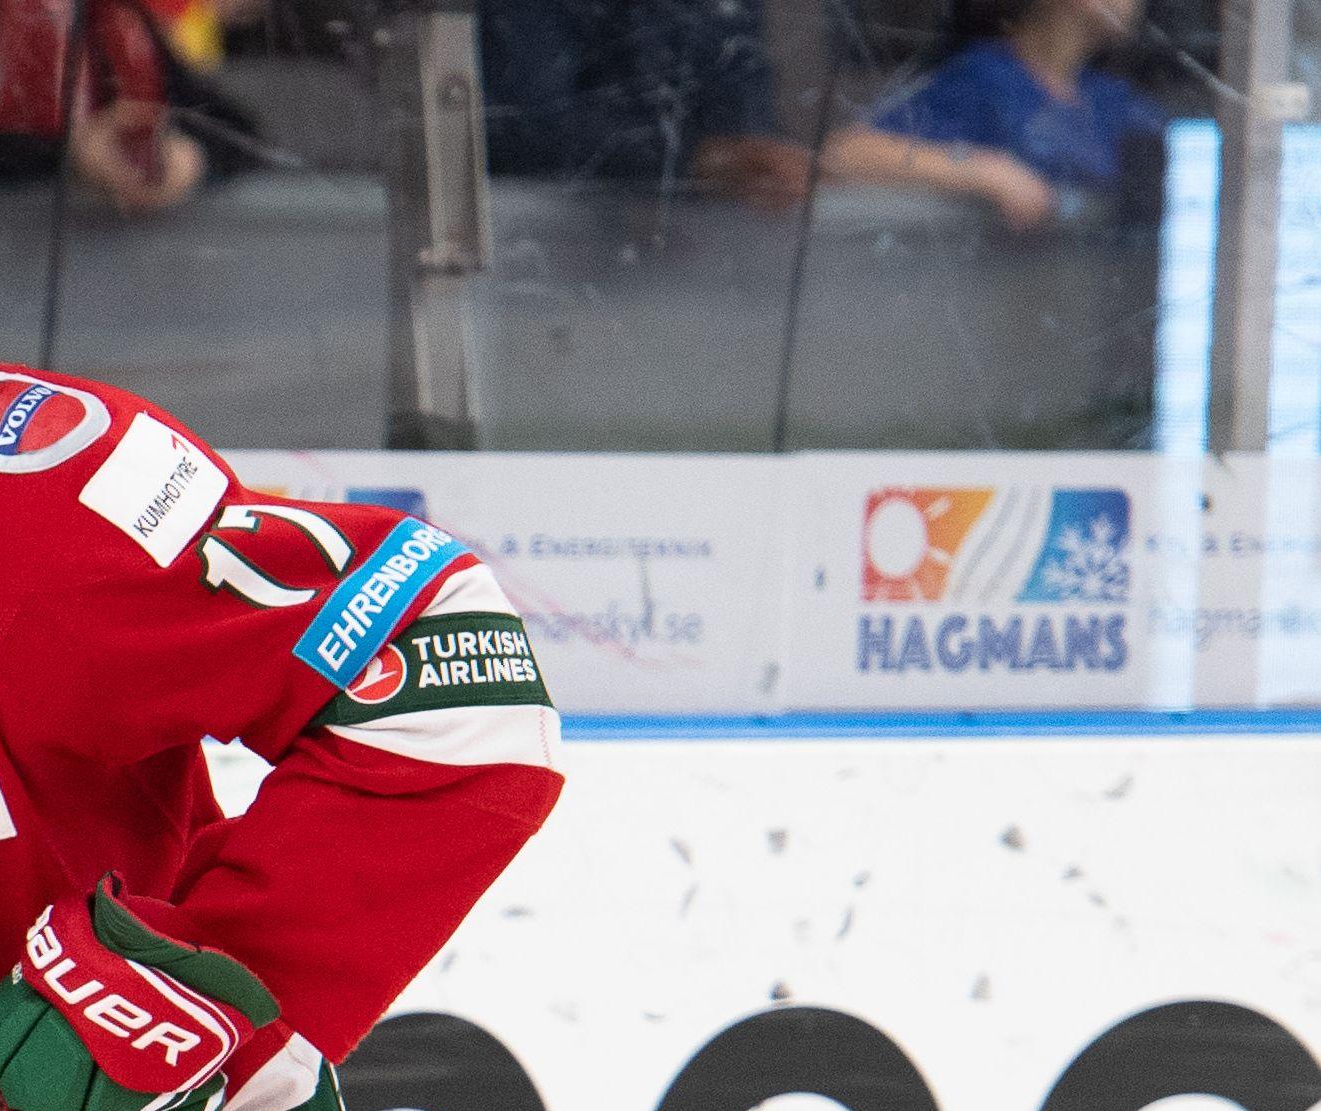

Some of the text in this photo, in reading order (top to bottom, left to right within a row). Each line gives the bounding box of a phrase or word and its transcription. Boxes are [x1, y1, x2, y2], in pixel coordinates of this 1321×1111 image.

[196, 503, 355, 608] 17
[412, 630, 533, 662] TURKISH
[856, 613, 1130, 675] HAGMANS
[418, 657, 537, 689] AIRLINES
